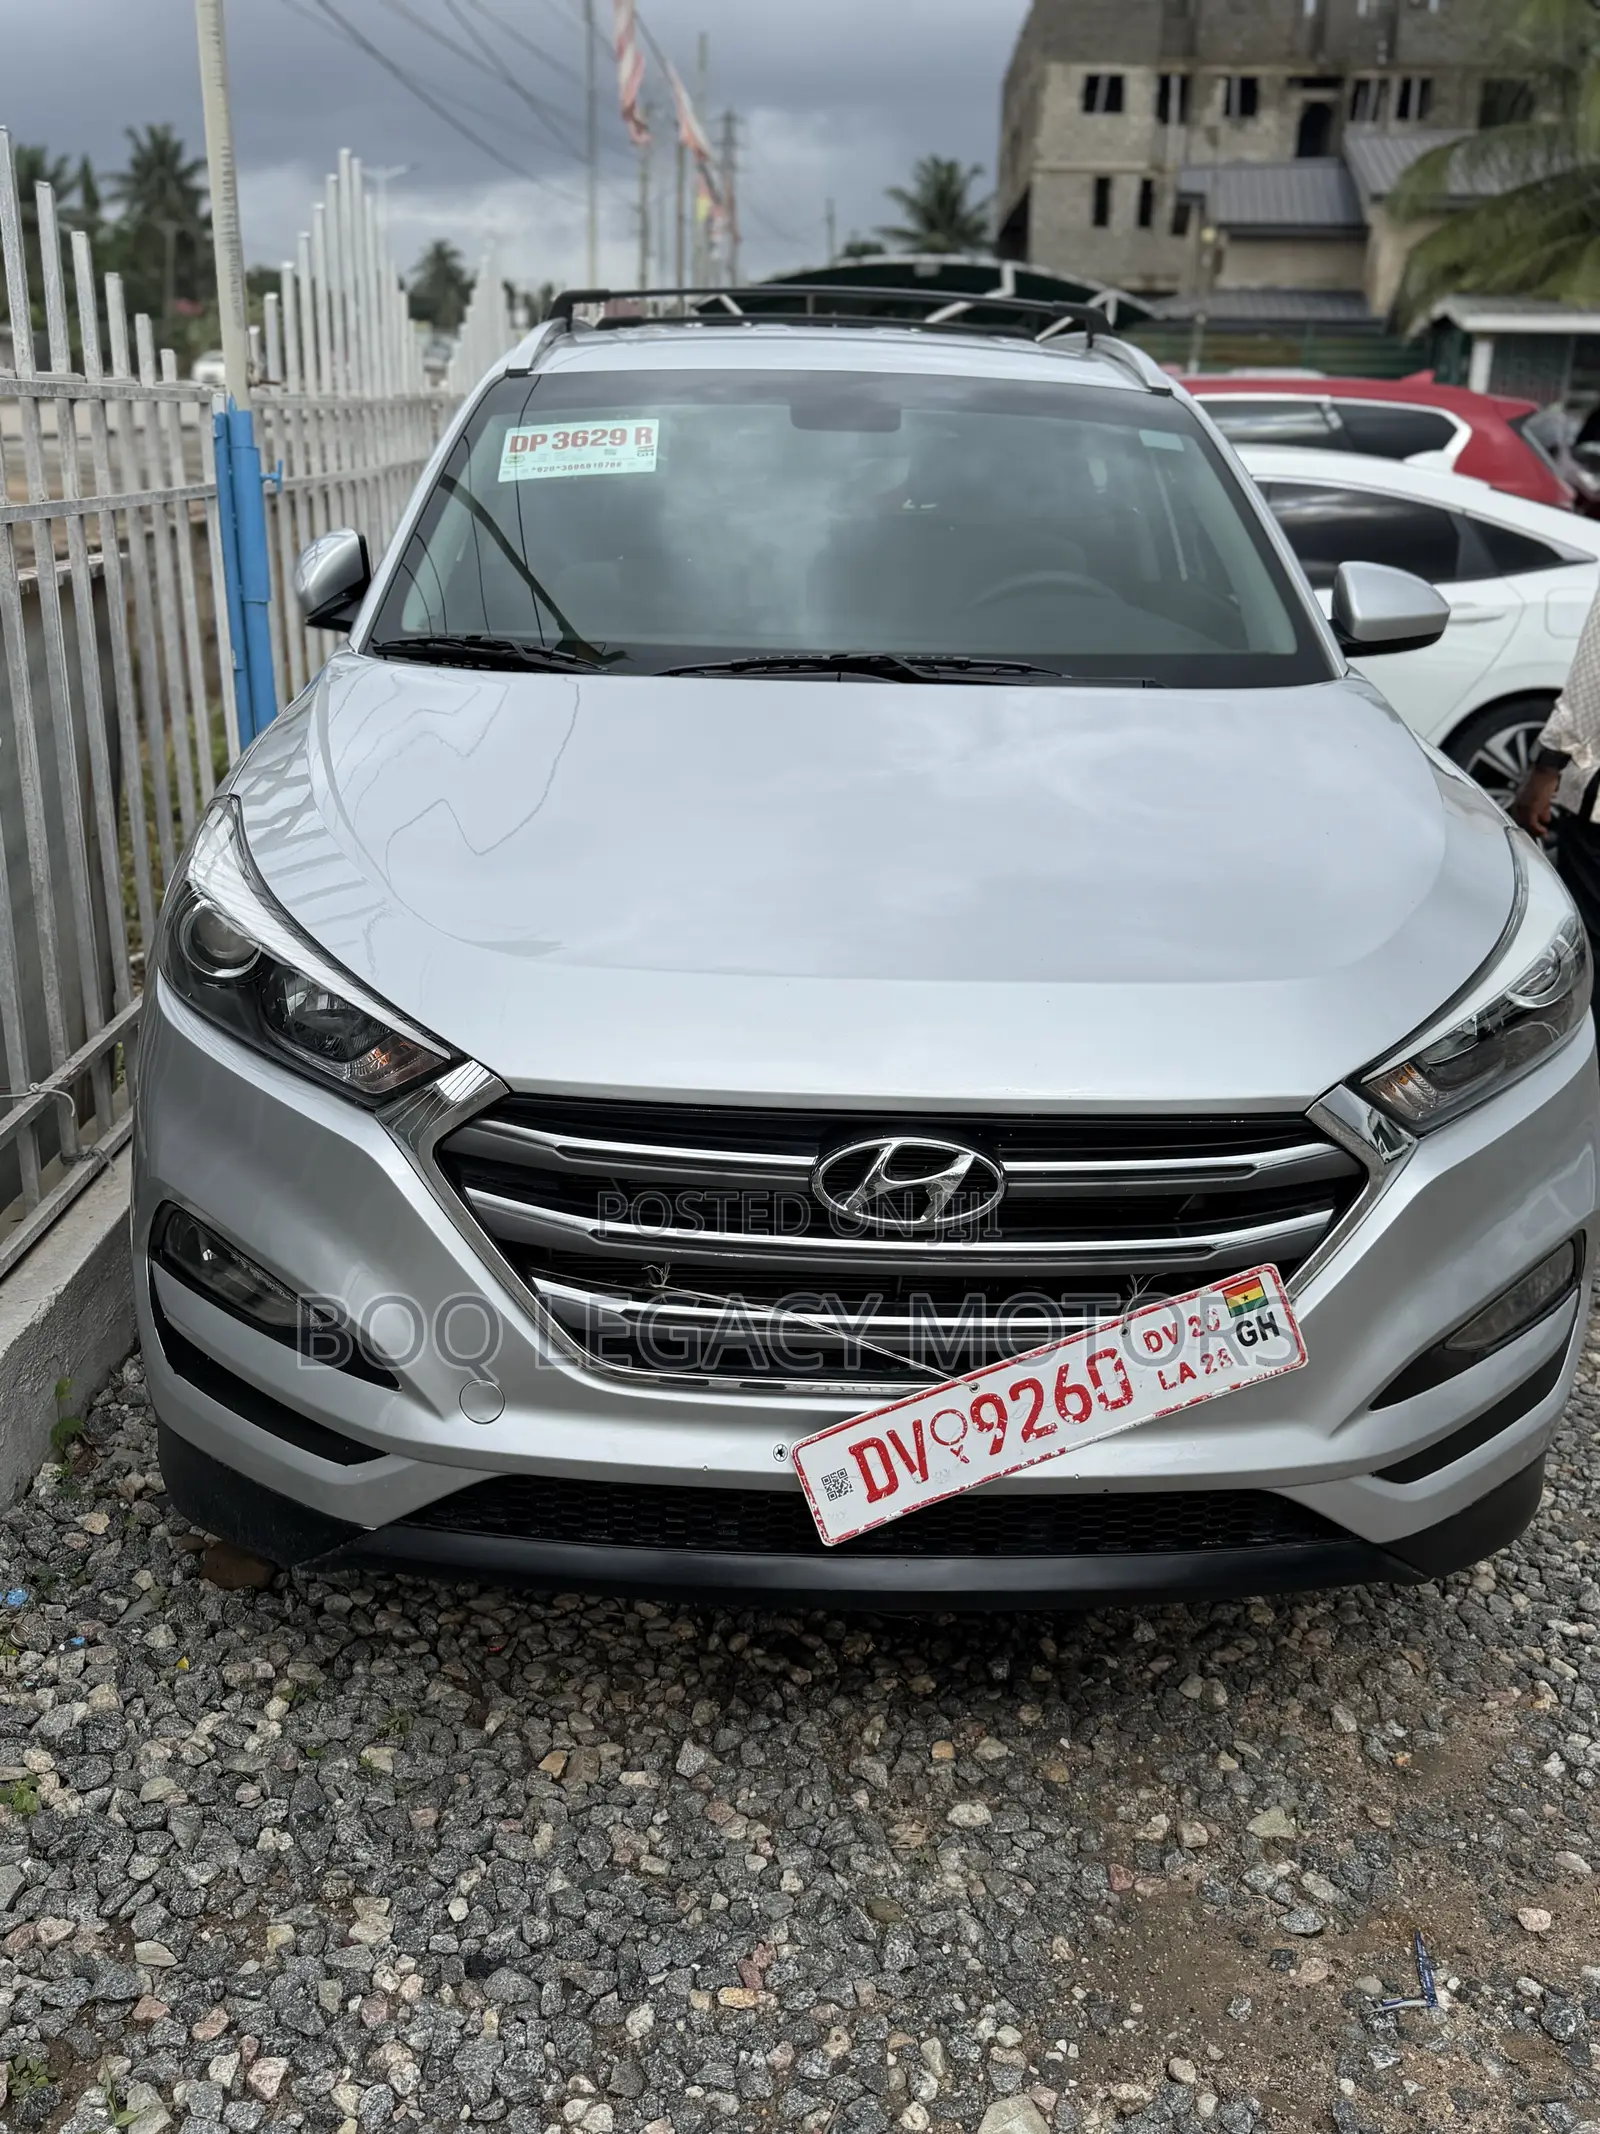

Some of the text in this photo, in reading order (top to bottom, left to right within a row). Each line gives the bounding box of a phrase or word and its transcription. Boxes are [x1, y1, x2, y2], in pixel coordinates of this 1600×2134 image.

[508, 426, 654, 453] DP 3629 R
[1143, 1322, 1179, 1353] DV
[1235, 1311, 1281, 1347] GH
[1157, 1361, 1198, 1391] LA
[848, 1347, 1134, 1504] DV 9260
